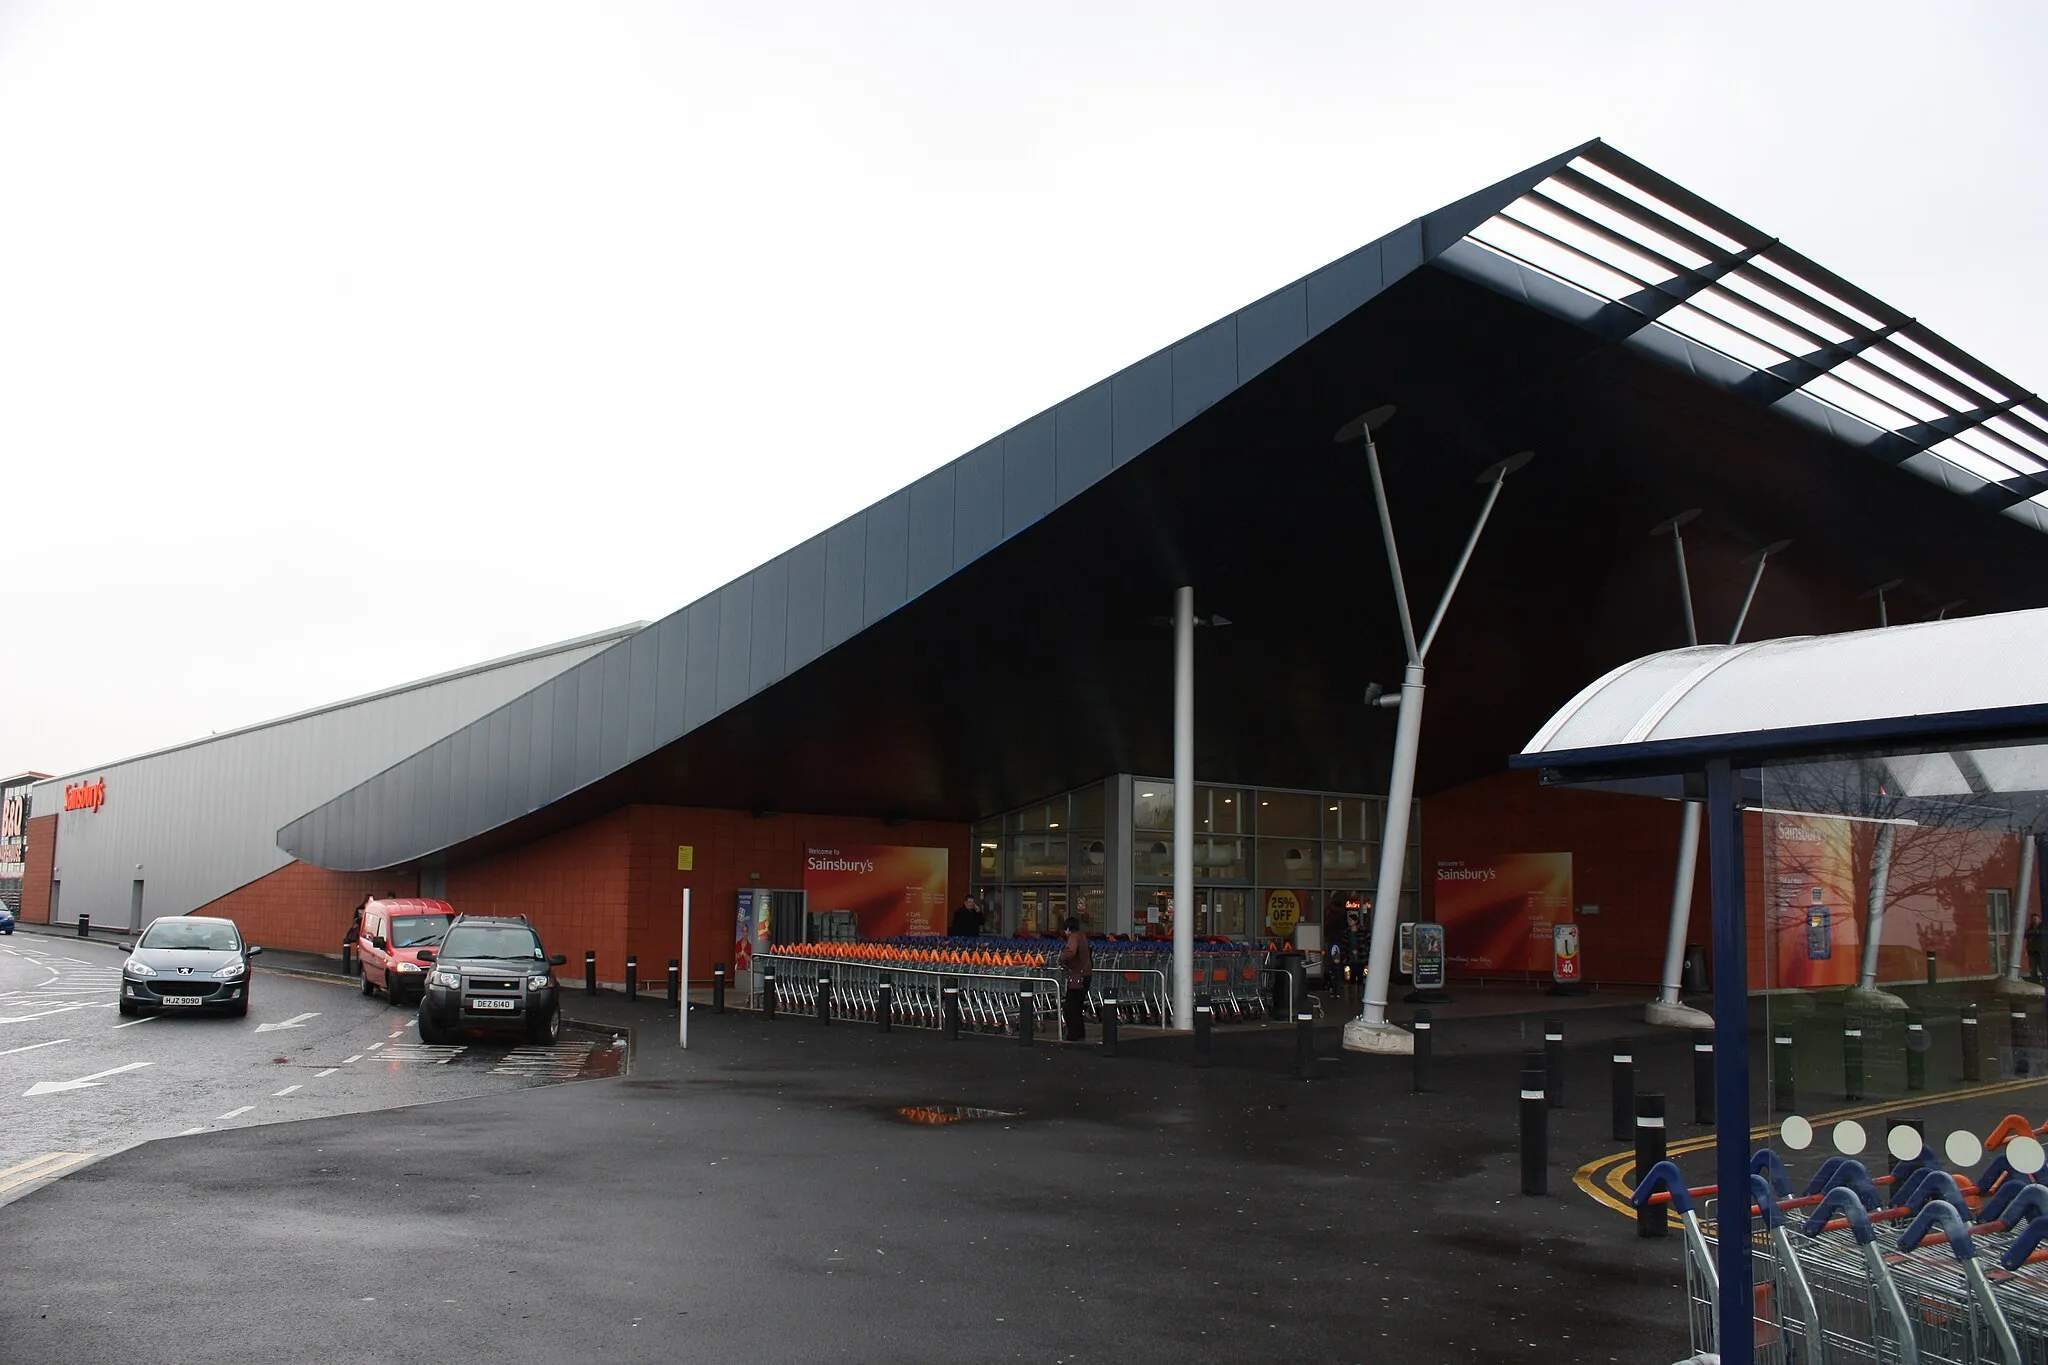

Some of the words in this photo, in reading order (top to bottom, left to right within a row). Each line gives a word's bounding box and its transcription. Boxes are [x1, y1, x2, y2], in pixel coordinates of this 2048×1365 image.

[64, 776, 105, 813] Sainsbury's
[2, 795, 23, 837] B&Q
[808, 857, 874, 875] Sainsbury's
[1437, 867, 1496, 882] Sainsbury's
[1271, 897, 1295, 908] 25%
[1273, 910, 1292, 921] OFF
[477, 1000, 492, 1008] DEZ
